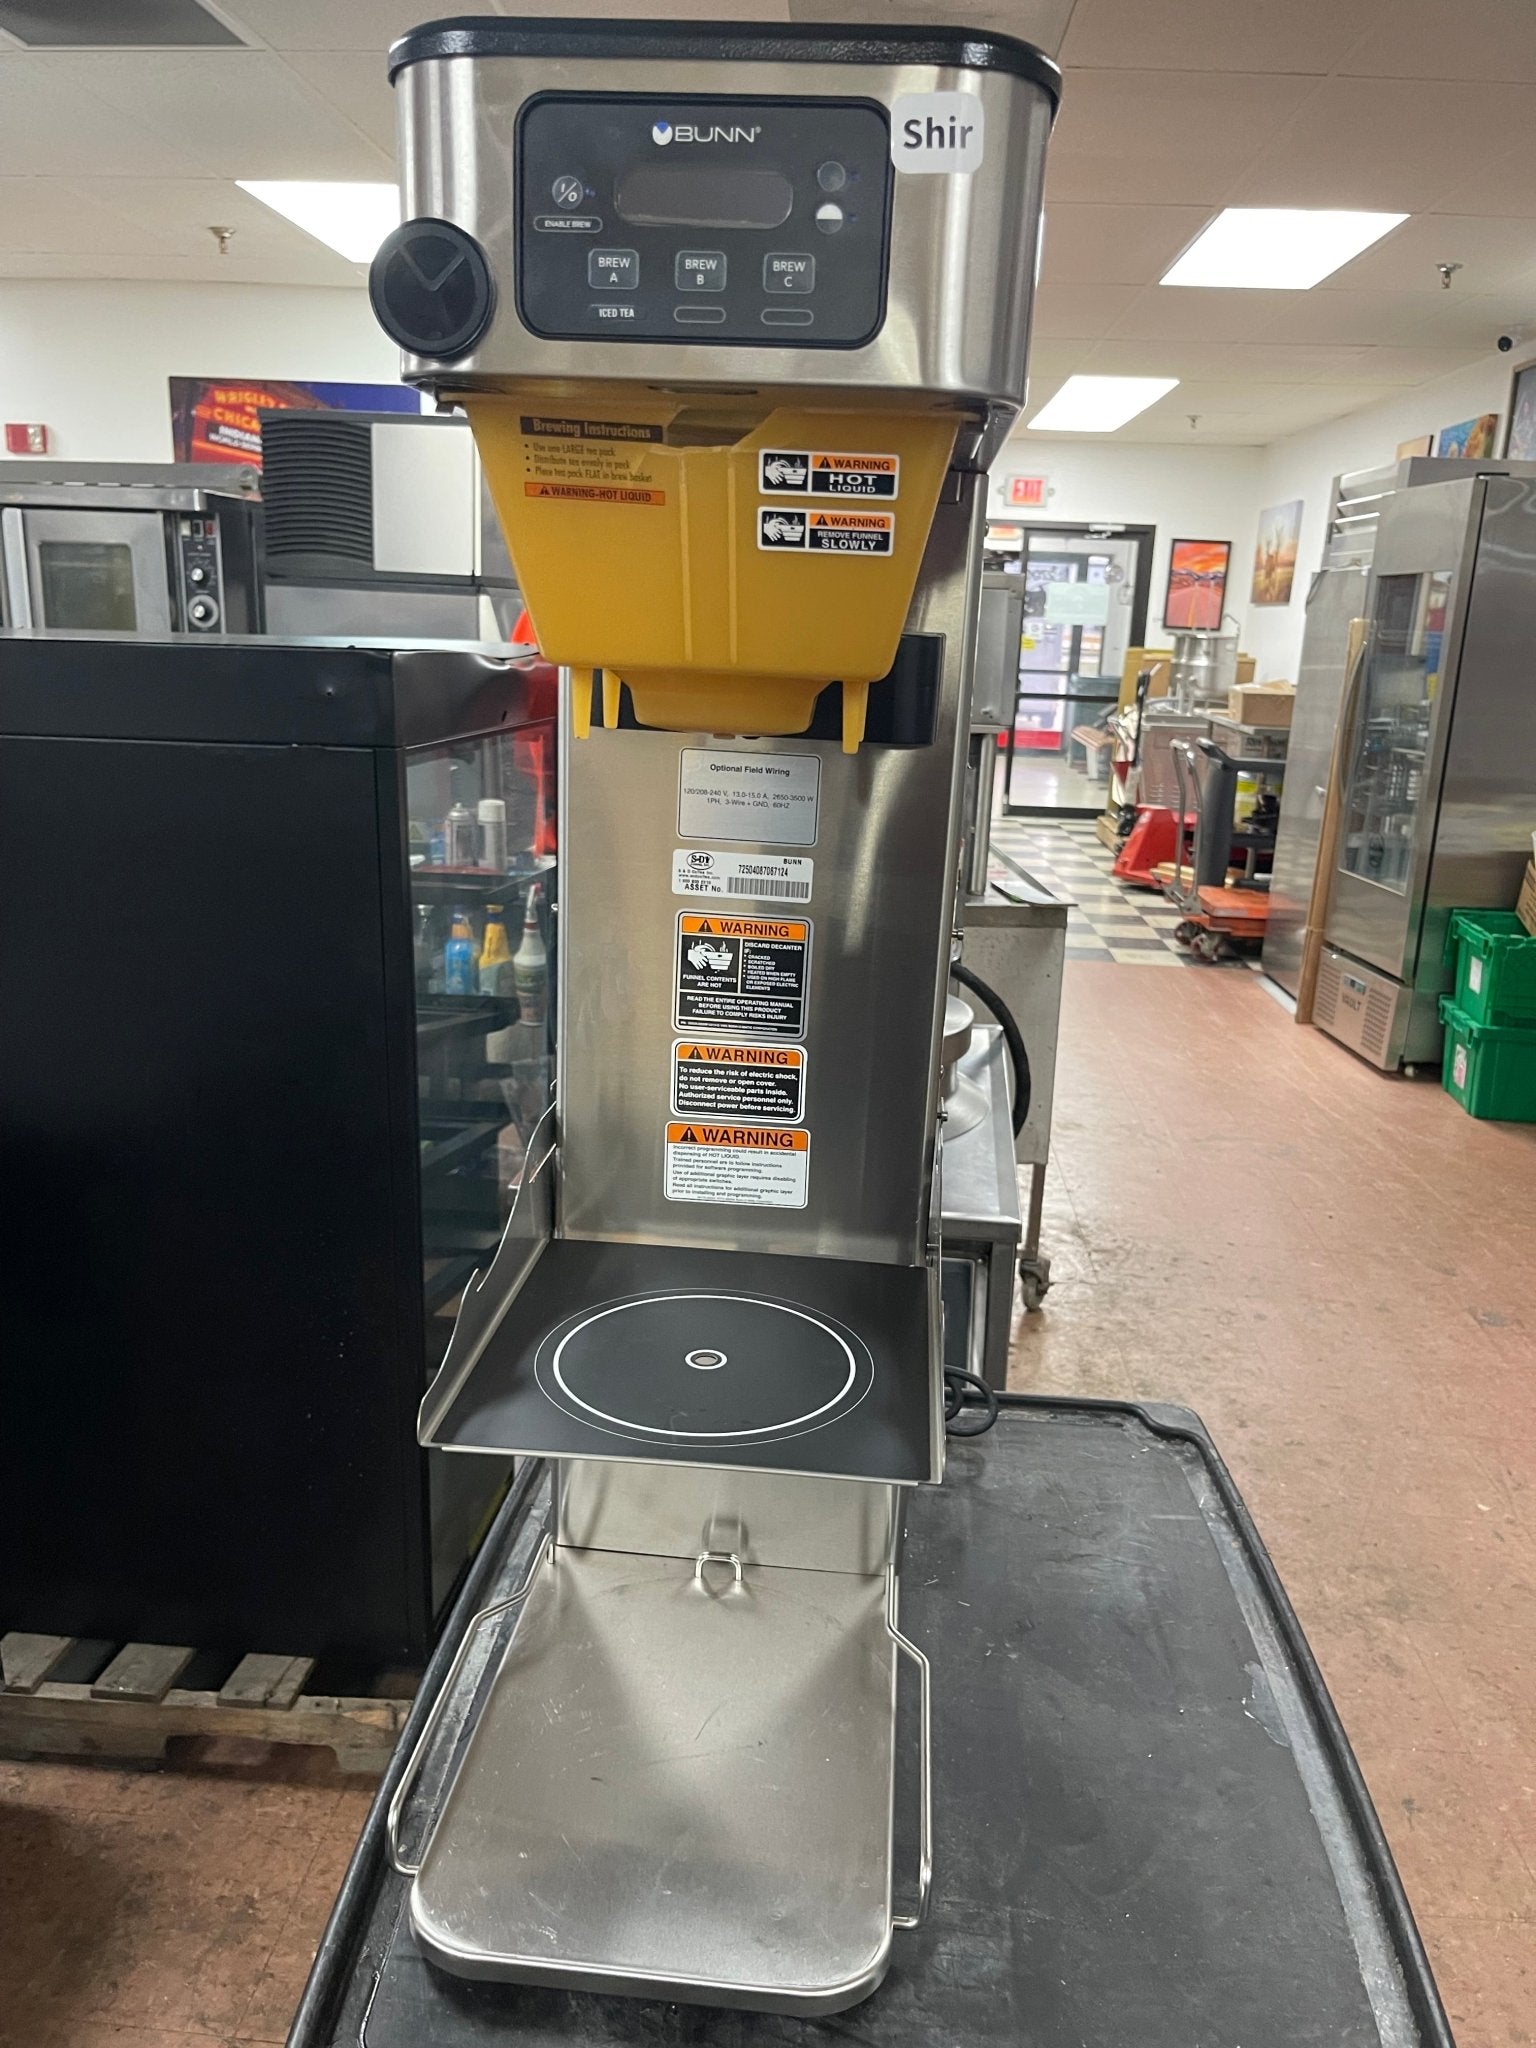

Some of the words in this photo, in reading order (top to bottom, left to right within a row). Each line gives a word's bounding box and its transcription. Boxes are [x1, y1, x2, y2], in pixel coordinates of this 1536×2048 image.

[675, 126, 755, 143] BUNN
[903, 115, 973, 150] Shir
[545, 220, 571, 228] ENABLE
[598, 257, 630, 269] BREW
[685, 259, 717, 271] BREW
[773, 261, 805, 273] BREW
[609, 272, 618, 283] A
[696, 273, 705, 285] B
[784, 276, 793, 288] C
[599, 308, 618, 318] ICED
[620, 308, 635, 318] TEA
[533, 419, 581, 437] Brewing
[584, 422, 651, 439] Instructions
[562, 444, 584, 454] LARGE
[834, 459, 890, 471] WARNING
[585, 469, 600, 479] FLAT
[829, 473, 877, 486] HOT
[829, 484, 876, 493] LIQUID
[1013, 479, 1042, 502] EXIT
[620, 490, 652, 502] LIQUID
[830, 517, 885, 528] WARNING
[817, 531, 850, 539] REMOVE
[852, 532, 883, 541] FUNNEL
[821, 538, 876, 550] SLOWLY
[710, 764, 742, 774] Optional
[766, 767, 790, 776] Wiring
[684, 883, 708, 891] ASSET
[720, 921, 790, 937] WARNING
[706, 975, 737, 983] CONTENTS
[706, 1047, 788, 1065] WARNING
[775, 1072, 797, 1080] shock,
[690, 1083, 745, 1093] user-serviceable
[746, 1087, 764, 1095] parts
[738, 1079, 754, 1087] open
[680, 1091, 715, 1099] Authorized
[742, 1095, 776, 1105] personnel
[778, 1097, 793, 1106] only.
[679, 1099, 716, 1108] Disconnect
[718, 1103, 738, 1111] power
[740, 1103, 761, 1111] before
[763, 1105, 795, 1114] servicing.
[703, 1128, 793, 1147] WARNING
